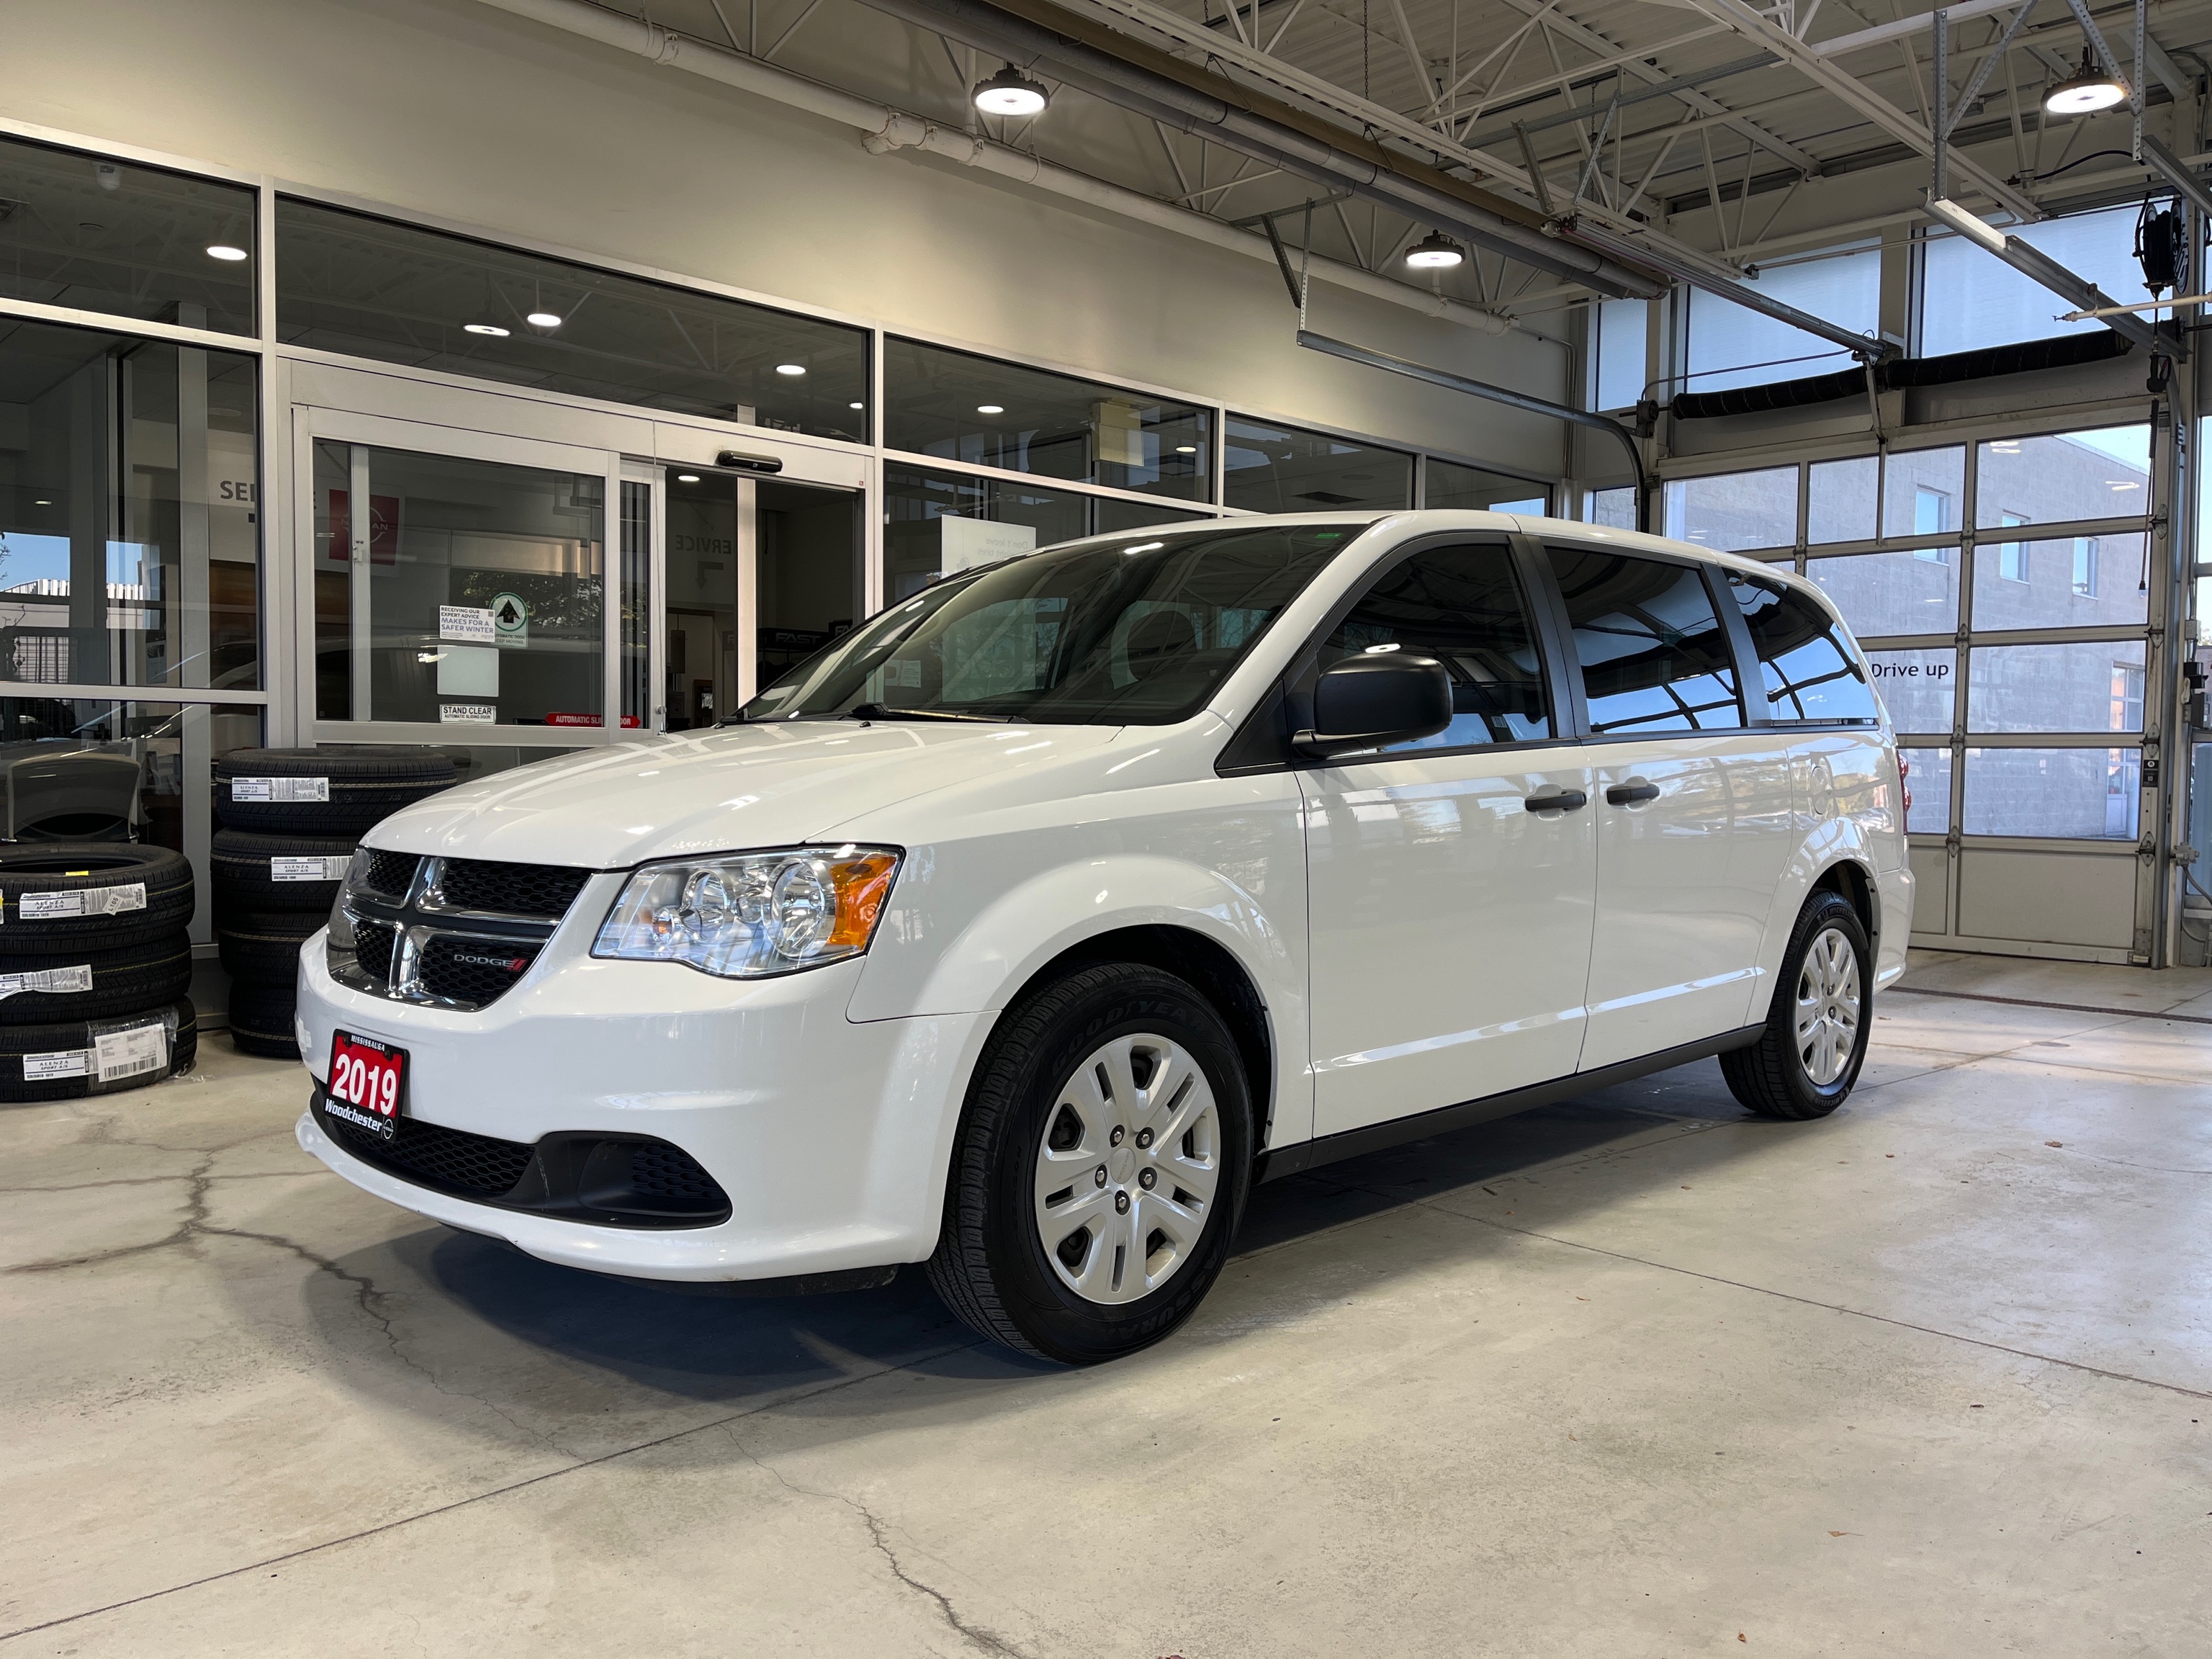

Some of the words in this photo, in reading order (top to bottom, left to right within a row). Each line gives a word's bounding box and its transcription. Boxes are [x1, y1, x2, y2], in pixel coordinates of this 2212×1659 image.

[775, 632, 821, 644] FAST
[1872, 662, 1919, 678] Drive
[1926, 665, 1948, 679] up
[556, 715, 590, 724] AUTOMATIC
[109, 897, 118, 912] L105
[454, 954, 514, 968] DODGE
[351, 1035, 385, 1051] MISSISSAUGA
[332, 1053, 396, 1115] 2019
[325, 1098, 382, 1132] Woodchester
